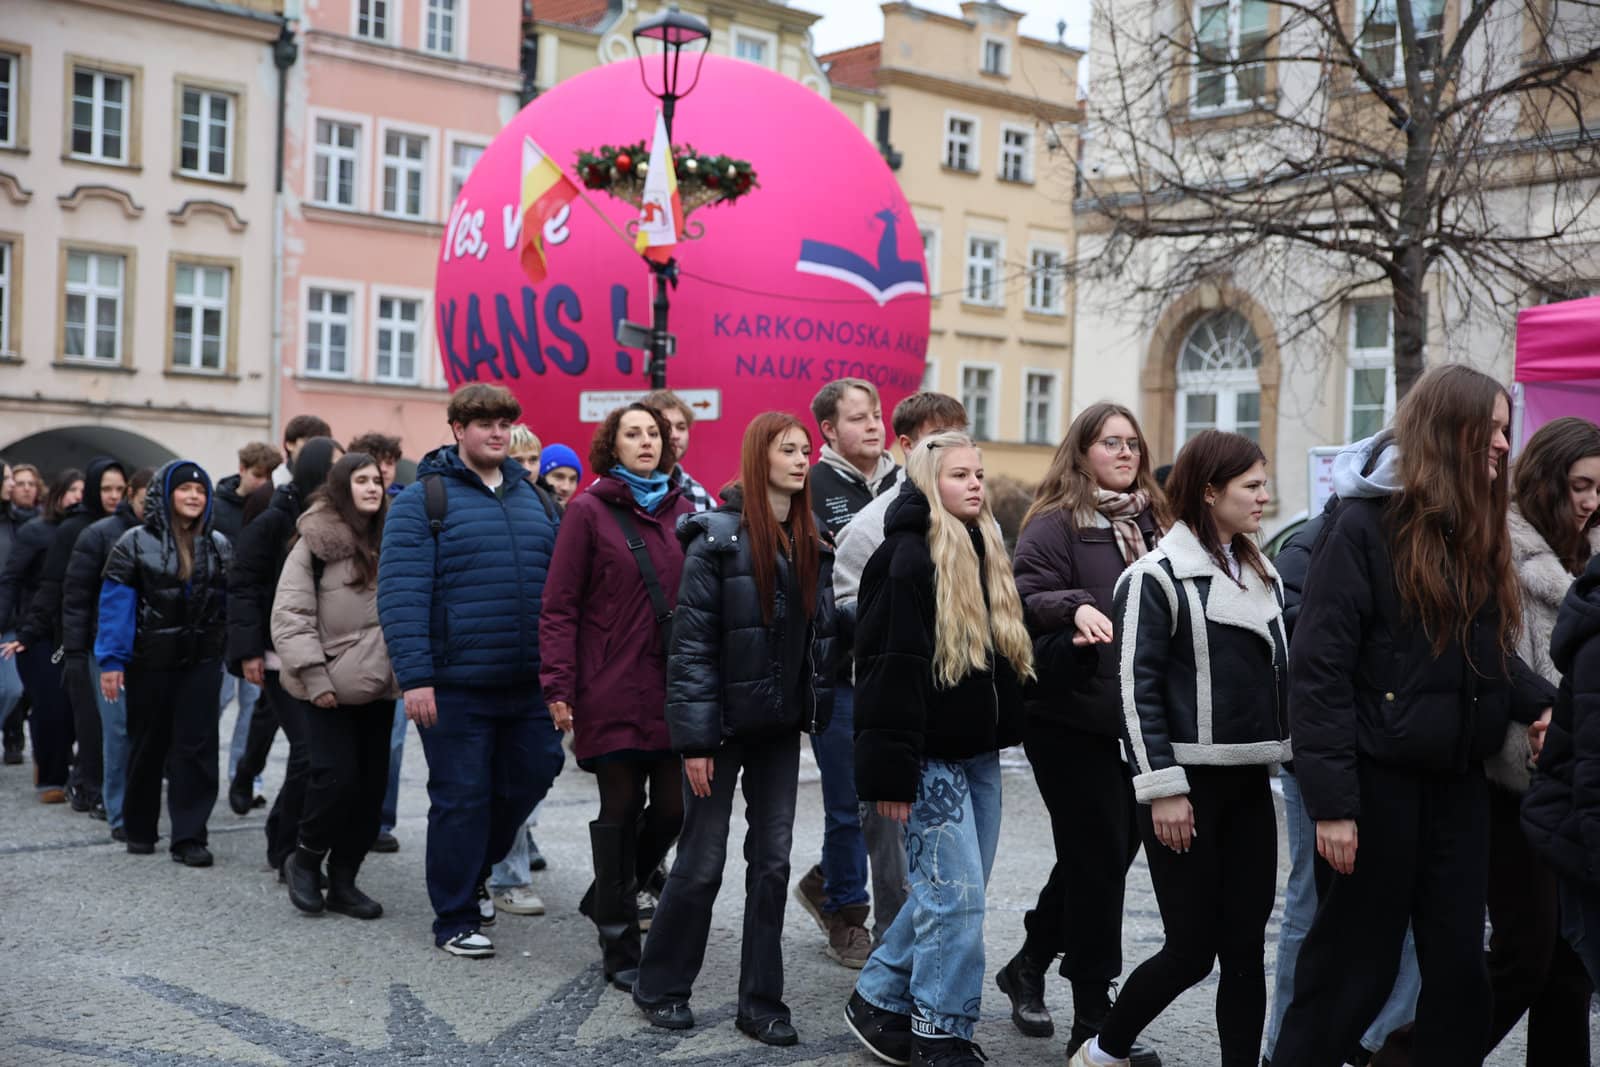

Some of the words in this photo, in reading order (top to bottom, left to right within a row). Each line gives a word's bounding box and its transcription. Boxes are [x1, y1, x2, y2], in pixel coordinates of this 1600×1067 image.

[443, 199, 488, 262] Yes,
[441, 284, 589, 384] KANS
[713, 313, 889, 350] KARKONOSKA
[735, 354, 815, 381] NAUK
